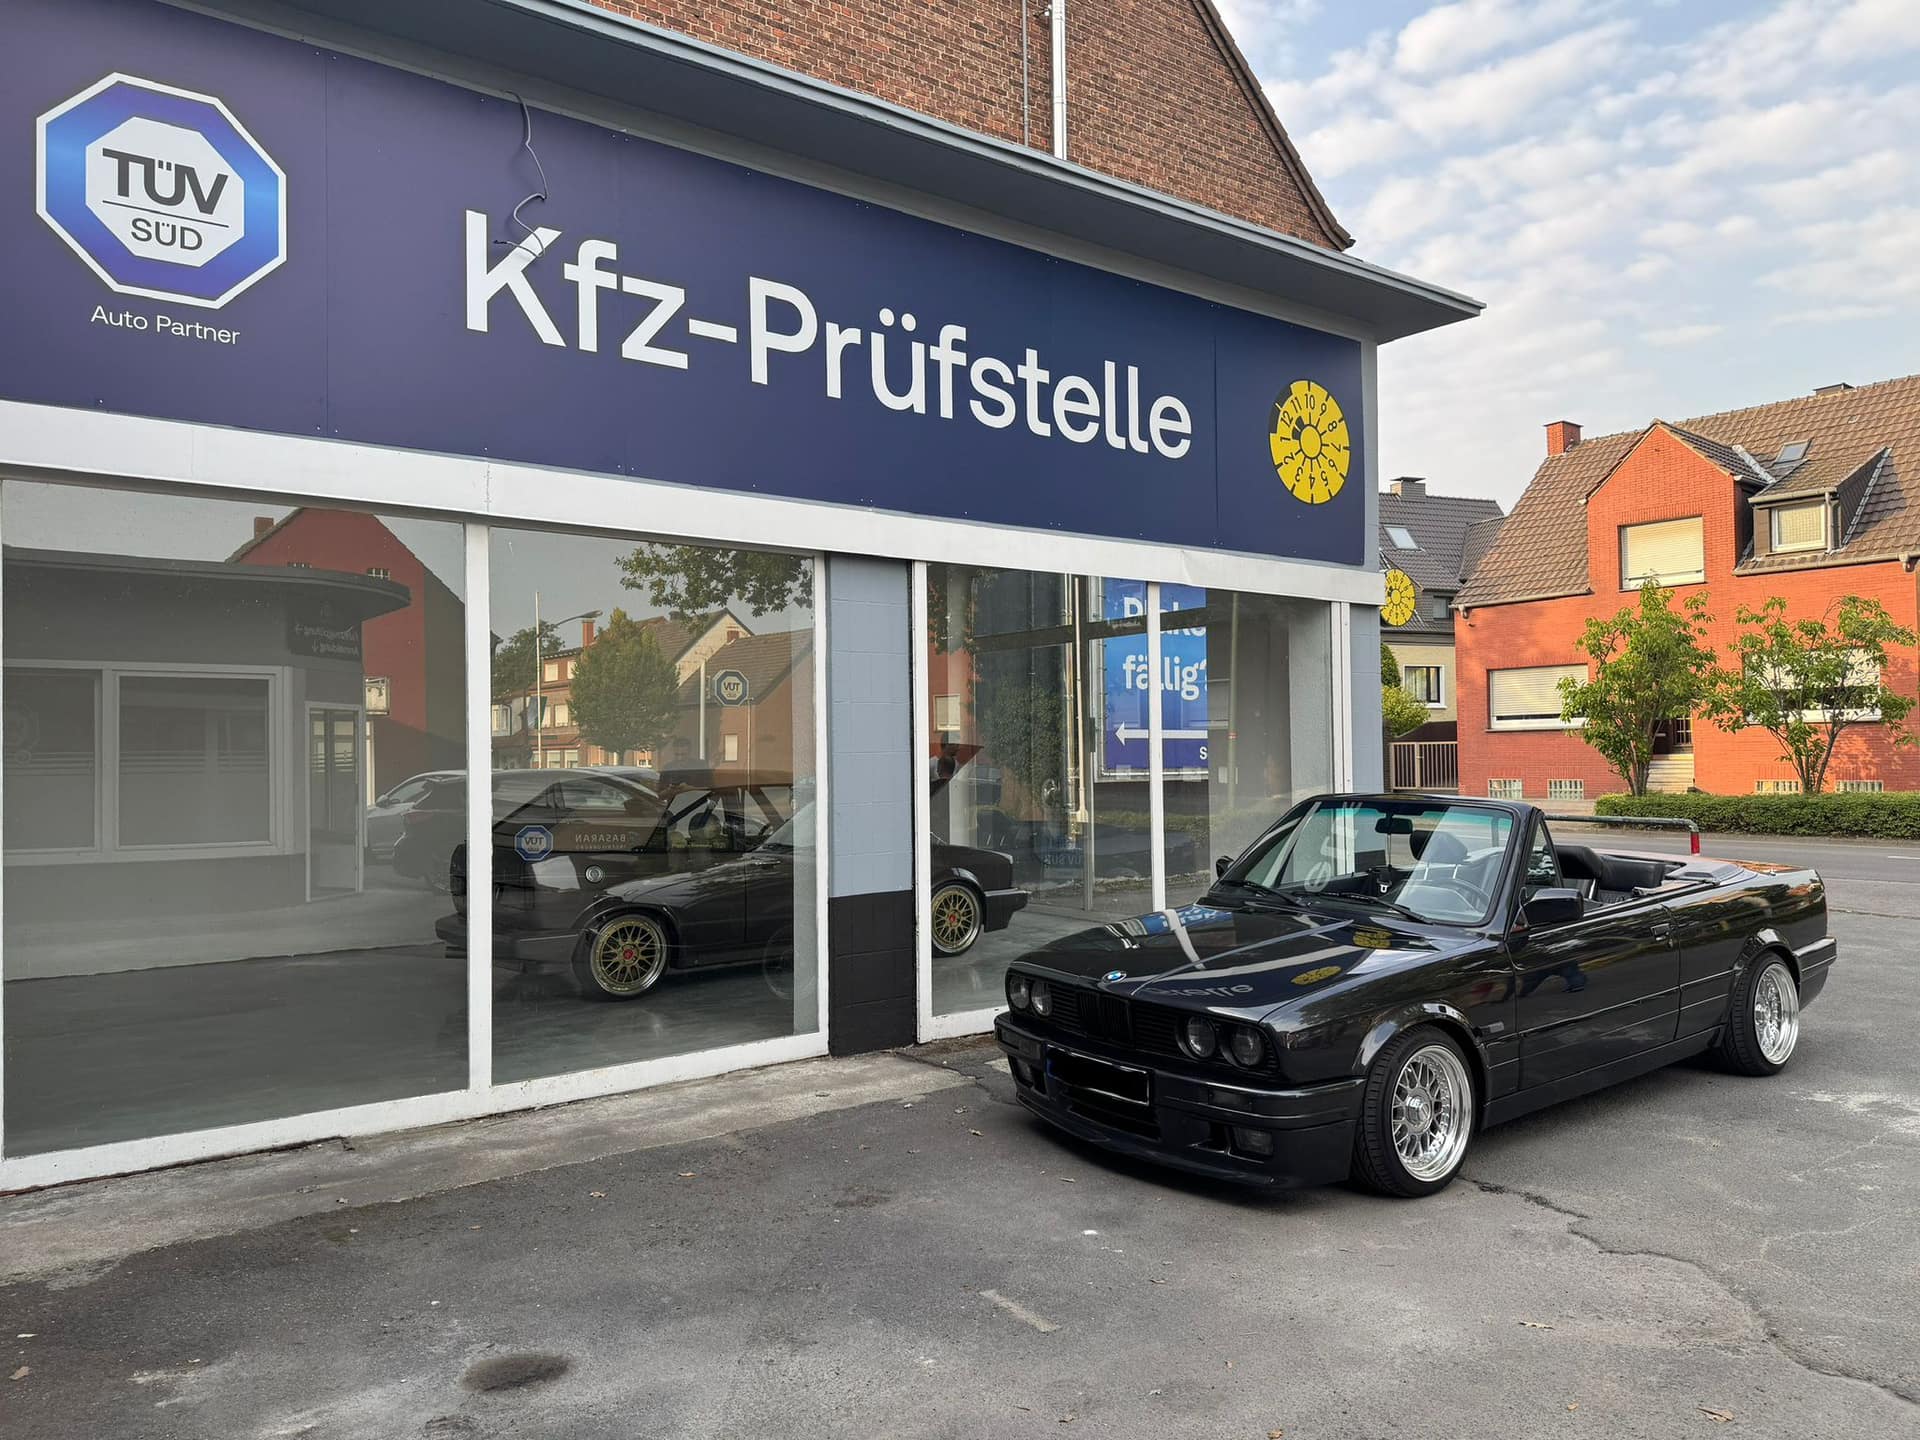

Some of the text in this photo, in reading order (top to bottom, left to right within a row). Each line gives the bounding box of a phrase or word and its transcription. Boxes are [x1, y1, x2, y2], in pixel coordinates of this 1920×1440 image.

[102, 147, 229, 215] TÜV
[131, 217, 203, 251] SÜD
[91, 305, 241, 345] Auto Partner
[466, 209, 1192, 459] Kfz-Prüfstelle
[1291, 397, 1302, 413] 11
[1305, 394, 1315, 410] 10
[1319, 403, 1327, 416] 9
[1281, 411, 1293, 427] 12
[1328, 421, 1337, 432] 8
[1331, 443, 1341, 452] 7
[1284, 452, 1295, 465] 2
[1295, 467, 1303, 482] 3
[1309, 473, 1316, 489] 4
[1321, 471, 1329, 486] 5
